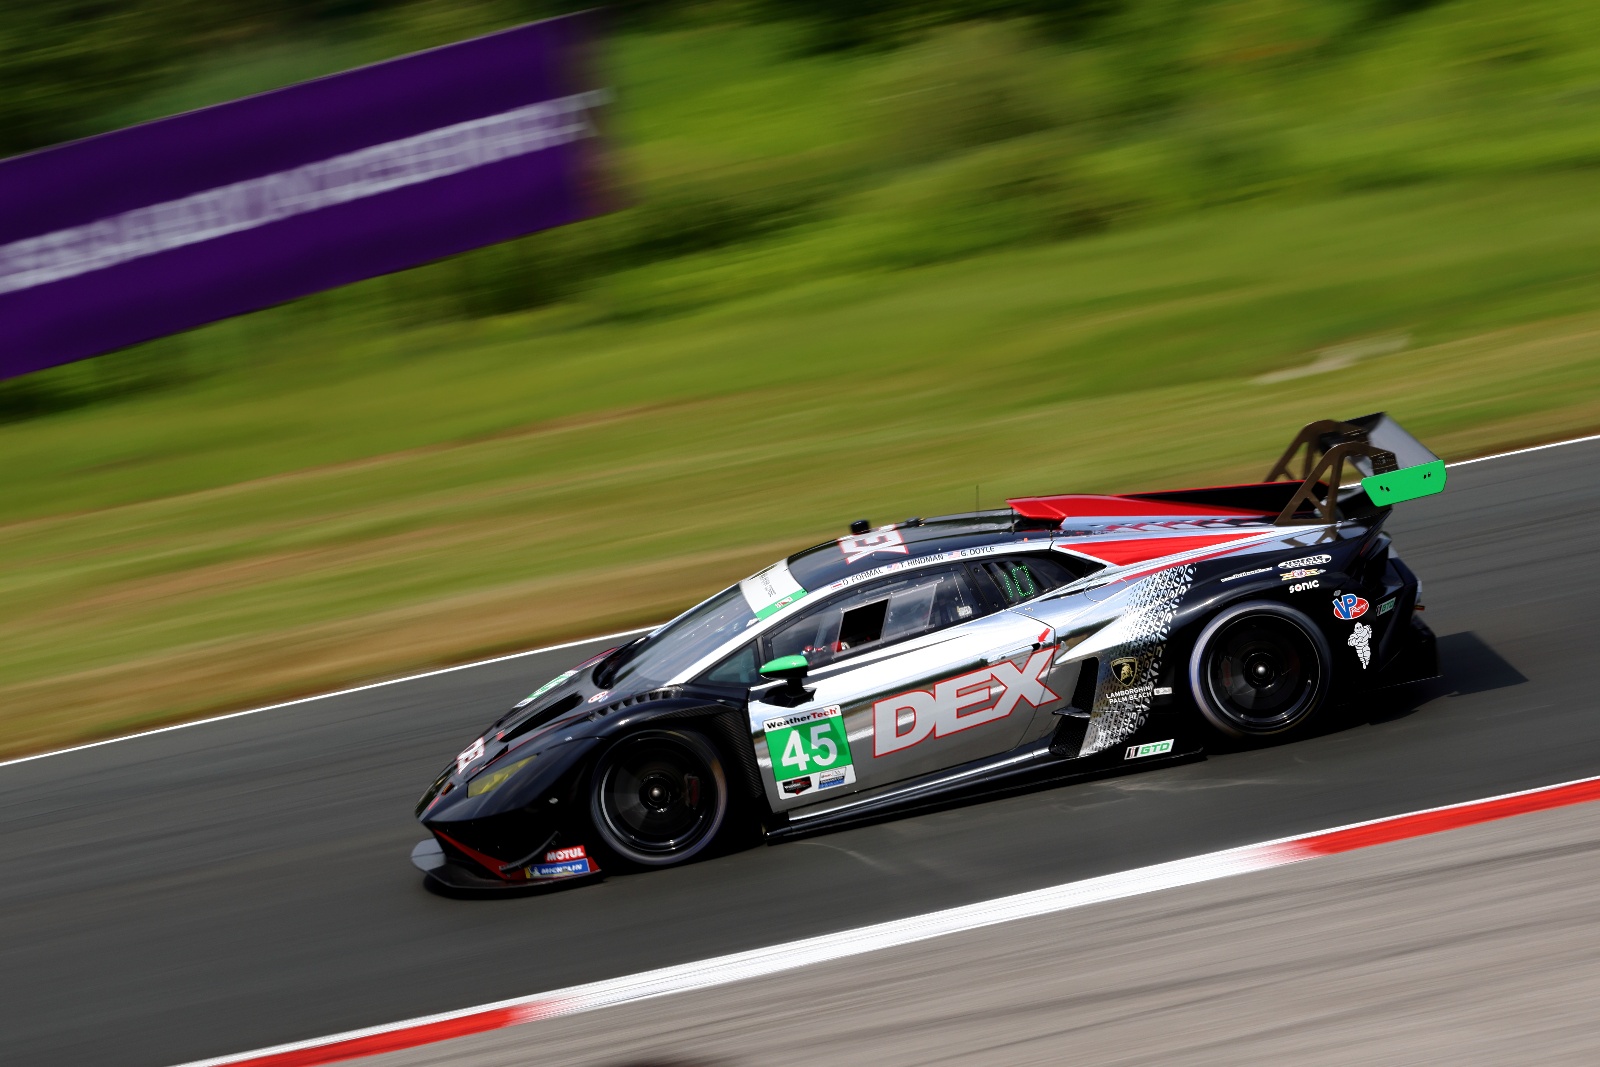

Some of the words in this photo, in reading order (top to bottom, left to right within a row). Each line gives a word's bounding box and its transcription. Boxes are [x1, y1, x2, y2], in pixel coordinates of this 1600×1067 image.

[851, 568, 884, 583] FORMAL
[907, 553, 944, 567] HINDMAN
[969, 546, 995, 556] DOYLE
[1332, 593, 1358, 619] VP
[873, 644, 1062, 759] DEX
[1106, 685, 1153, 699] LAMBORGHINI
[1109, 696, 1128, 704] PALM
[1129, 692, 1152, 701] BEACH
[766, 708, 837, 729] WeatherTech
[781, 723, 838, 772] 45
[1140, 742, 1170, 755] GTD
[546, 847, 584, 861] MOTUL
